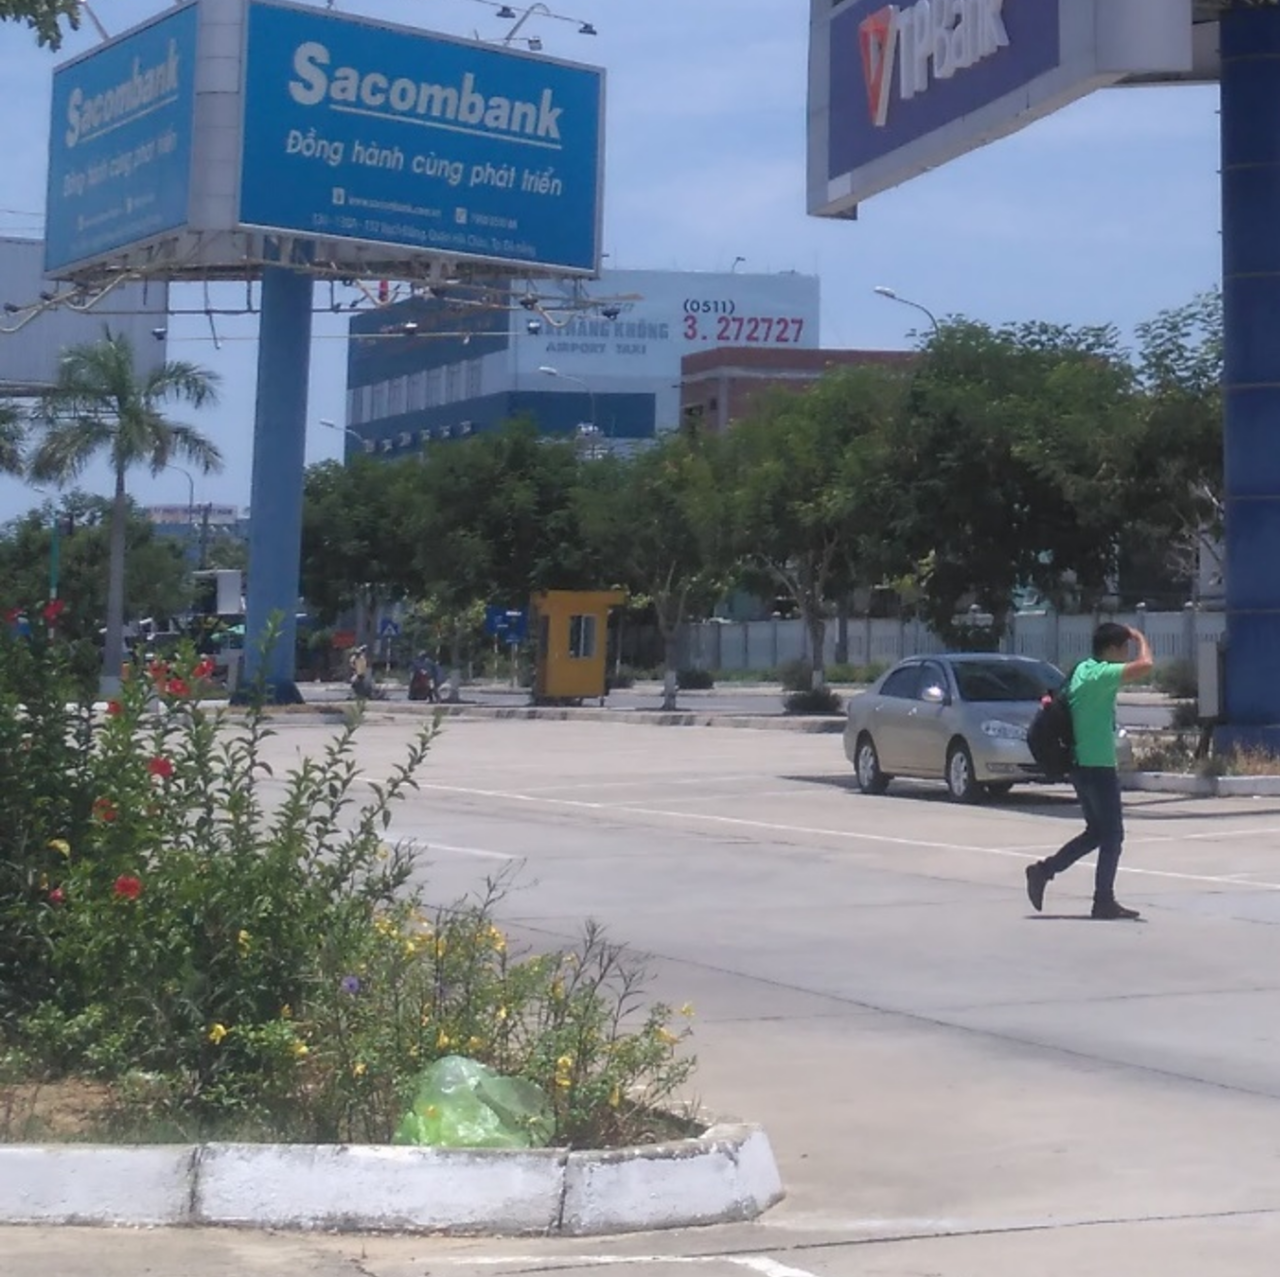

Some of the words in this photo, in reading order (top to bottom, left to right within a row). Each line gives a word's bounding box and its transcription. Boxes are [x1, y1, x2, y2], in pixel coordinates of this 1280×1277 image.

[66, 38, 179, 148] Sacombank
[288, 41, 564, 140] Sacombank
[286, 127, 344, 167] Đồng
[352, 140, 404, 171] hành
[412, 151, 463, 186] cùng
[683, 299, 736, 314] (0511)
